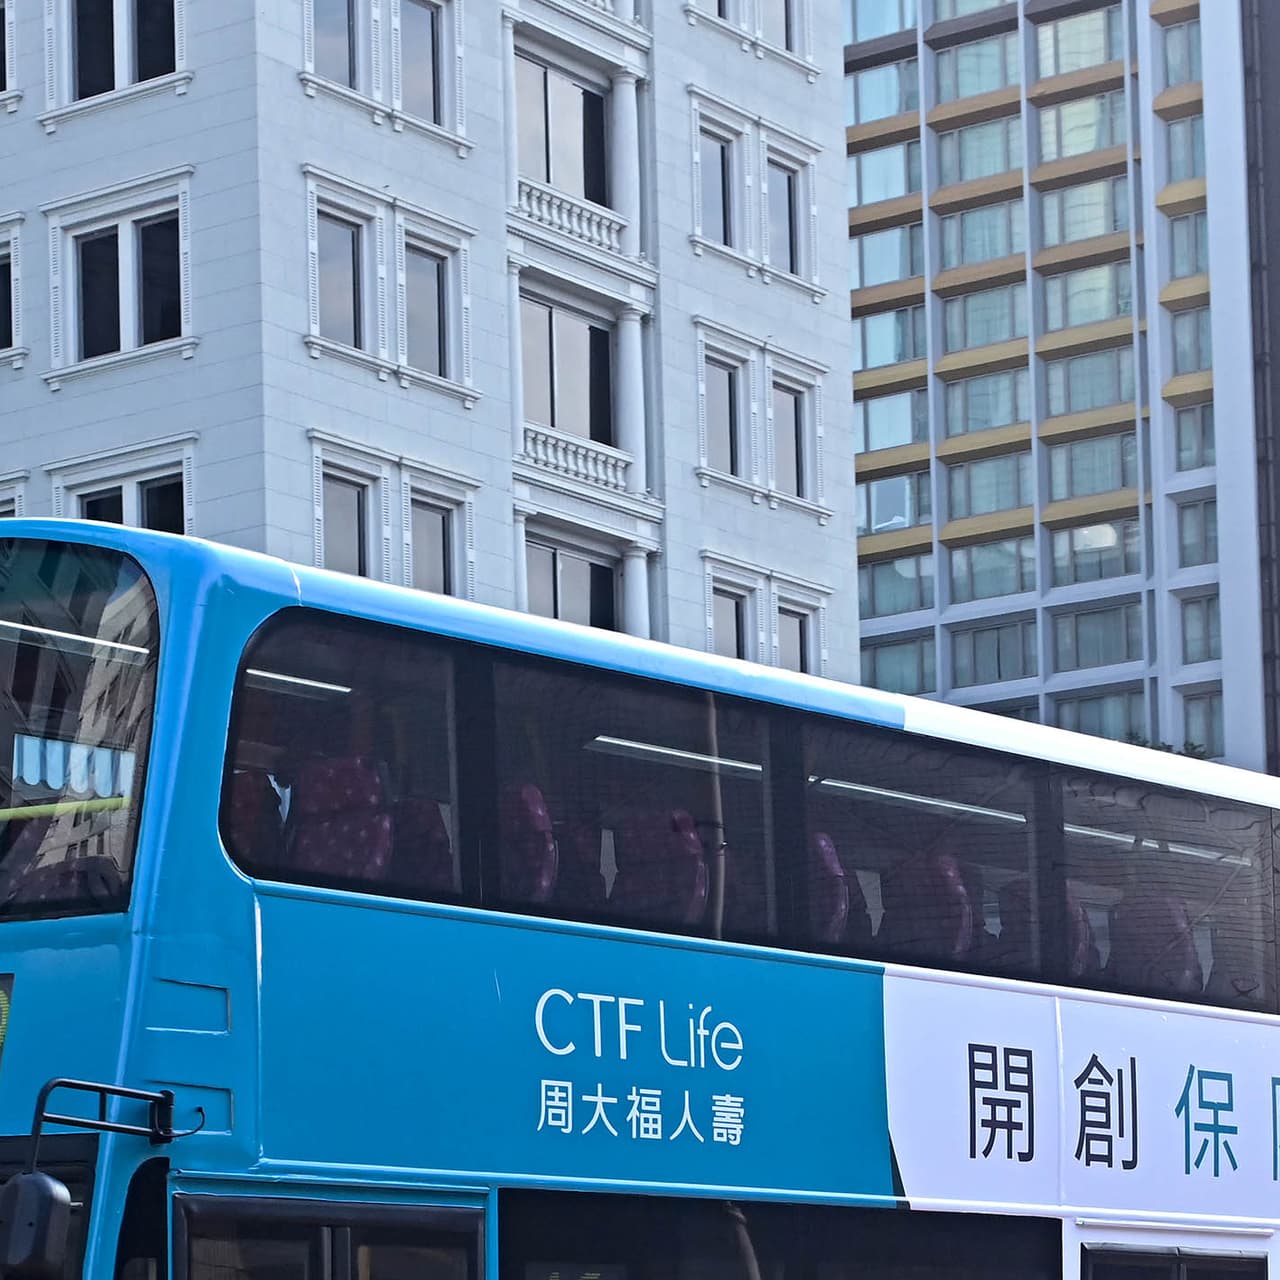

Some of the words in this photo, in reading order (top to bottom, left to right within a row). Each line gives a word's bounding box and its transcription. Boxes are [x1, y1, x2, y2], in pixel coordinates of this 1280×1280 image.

[535, 988, 644, 1060] CTF
[659, 1000, 744, 1070] Life
[537, 1079, 745, 1146] 周大福人壽
